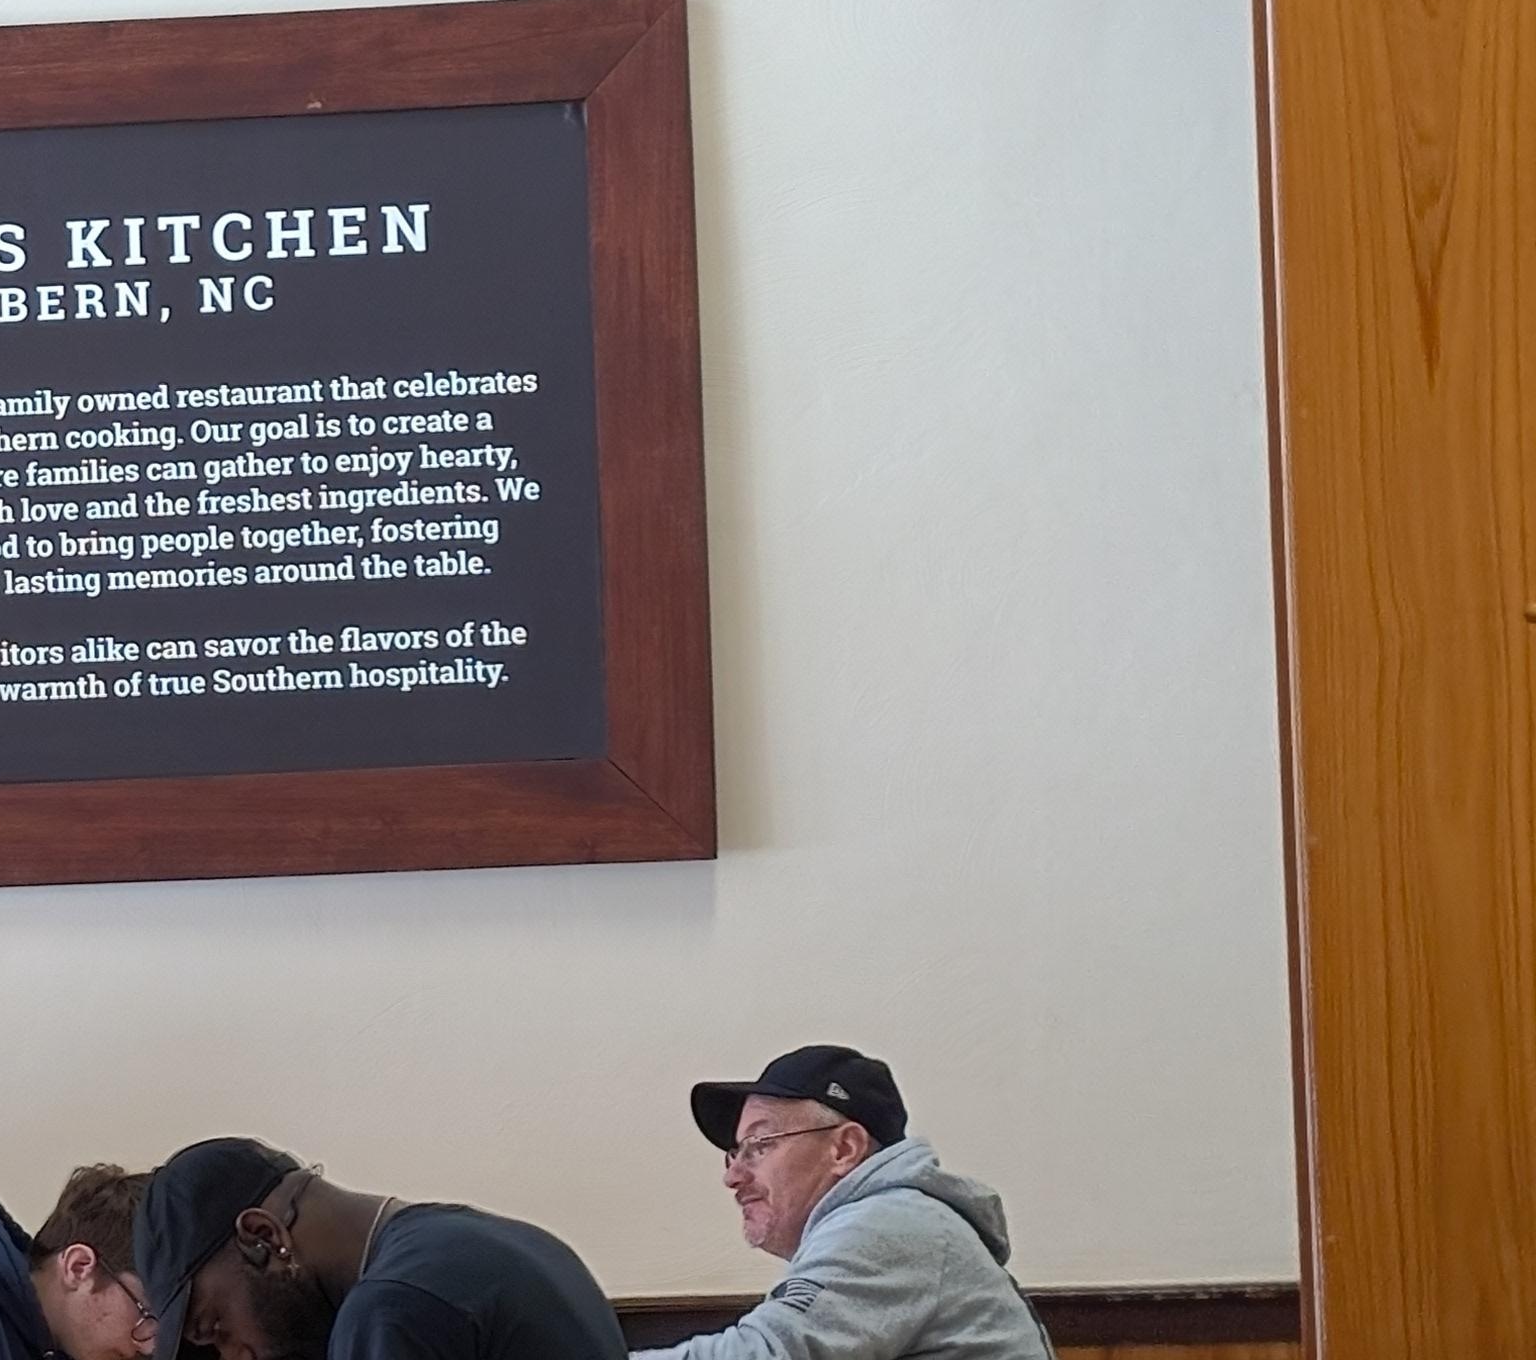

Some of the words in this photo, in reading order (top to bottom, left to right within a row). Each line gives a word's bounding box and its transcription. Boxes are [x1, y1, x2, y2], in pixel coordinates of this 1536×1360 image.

[66, 204, 429, 268] KITCHEN
[199, 276, 273, 313] NC
[78, 385, 170, 412] owned
[176, 381, 323, 408] restaurant
[329, 376, 387, 401] that
[394, 371, 537, 398] celebrates
[66, 422, 183, 450] cooking.
[191, 420, 243, 443] Our
[250, 414, 310, 446] goal
[315, 413, 341, 437] is
[347, 415, 375, 436] to
[383, 411, 468, 434] create
[476, 413, 493, 430] a
[26, 459, 139, 486] families
[146, 462, 197, 481] can
[204, 452, 294, 484] gather
[300, 453, 328, 474] to
[335, 446, 413, 477] enjoy
[419, 444, 517, 471] hearty,
[20, 498, 78, 522] love
[86, 493, 138, 519] and
[144, 492, 190, 516] the
[197, 488, 312, 514] freshest
[319, 480, 488, 514] ingredients.
[495, 478, 539, 501] We
[26, 536, 53, 557] to
[59, 531, 133, 560] bring
[141, 526, 234, 558] people
[241, 521, 363, 553] together,
[371, 514, 498, 544] fostering
[4, 568, 100, 597] lasting
[107, 561, 247, 590] memories
[255, 555, 355, 583] around
[361, 554, 407, 579] the
[414, 550, 491, 576] table.
[71, 637, 139, 663] alike
[147, 641, 197, 660] can
[204, 637, 281, 657] savor
[287, 629, 333, 654] the
[340, 627, 438, 652] flavors
[446, 622, 474, 647] of
[480, 621, 526, 646] the
[114, 672, 142, 697] of
[148, 674, 205, 695] true
[213, 666, 343, 693] Southern
[349, 658, 508, 691] hospitality.
